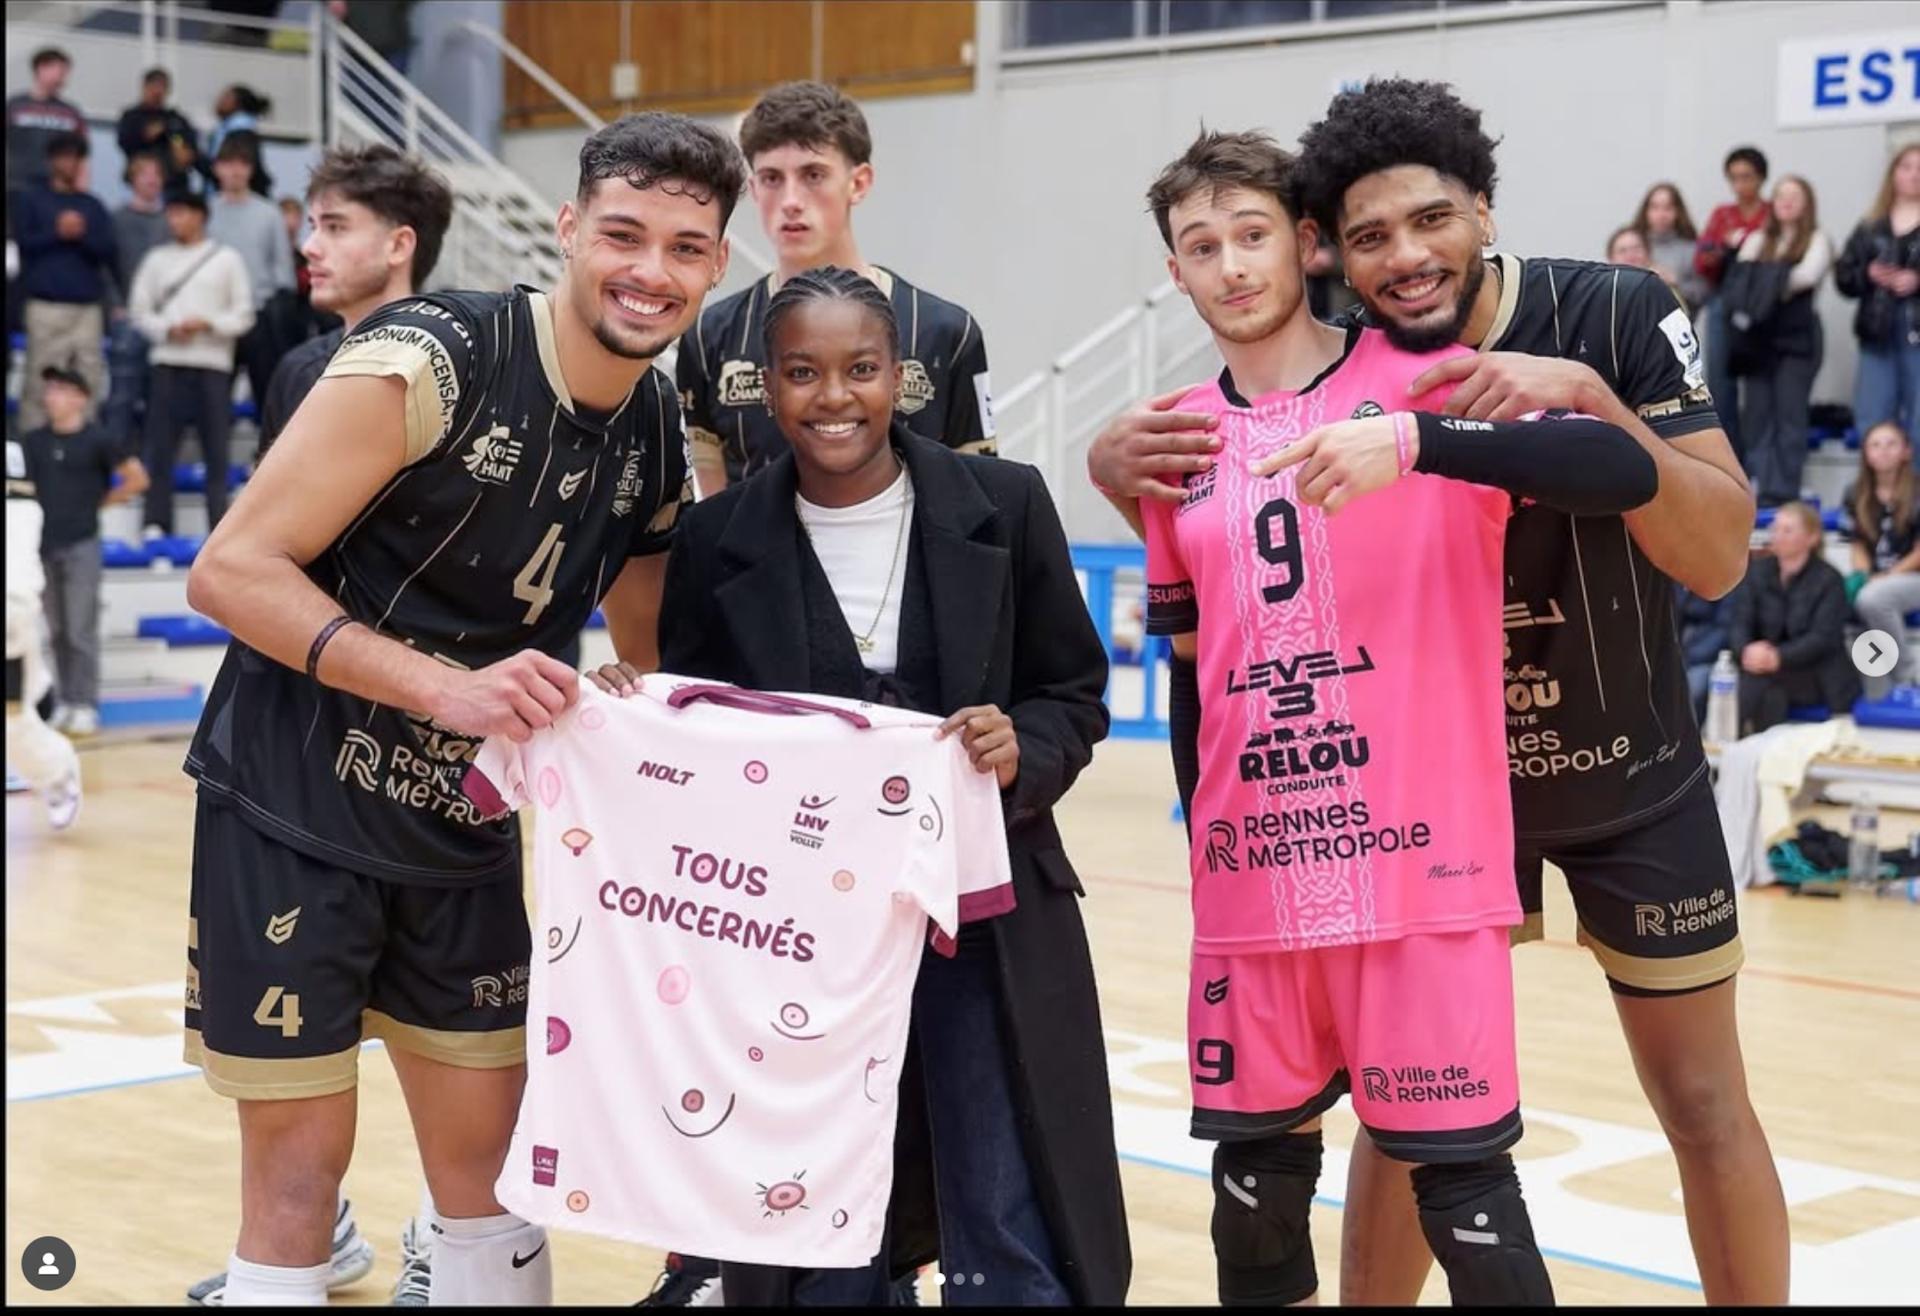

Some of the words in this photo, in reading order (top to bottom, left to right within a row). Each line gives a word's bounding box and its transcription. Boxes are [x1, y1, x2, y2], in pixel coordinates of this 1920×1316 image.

[1455, 420, 1495, 432] nine
[1255, 498, 1304, 604] 9
[513, 523, 566, 625] 4
[1226, 645, 1375, 696] LEVEL
[1268, 682, 1316, 720] 3
[1505, 680, 1561, 711] OU
[637, 761, 695, 786] NOLT
[1239, 736, 1369, 782] RELOU
[1267, 775, 1346, 796] CONDUITE
[794, 812, 829, 831] LNV
[672, 844, 768, 897] TOUS
[599, 879, 815, 963] CONCERNÉS
[1669, 897, 1708, 917] Ville
[1710, 888, 1725, 906] de
[253, 986, 303, 1037] 4
[1196, 1038, 1234, 1085] 9
[1392, 1066, 1436, 1083] Ville
[1442, 1064, 1469, 1081] de
